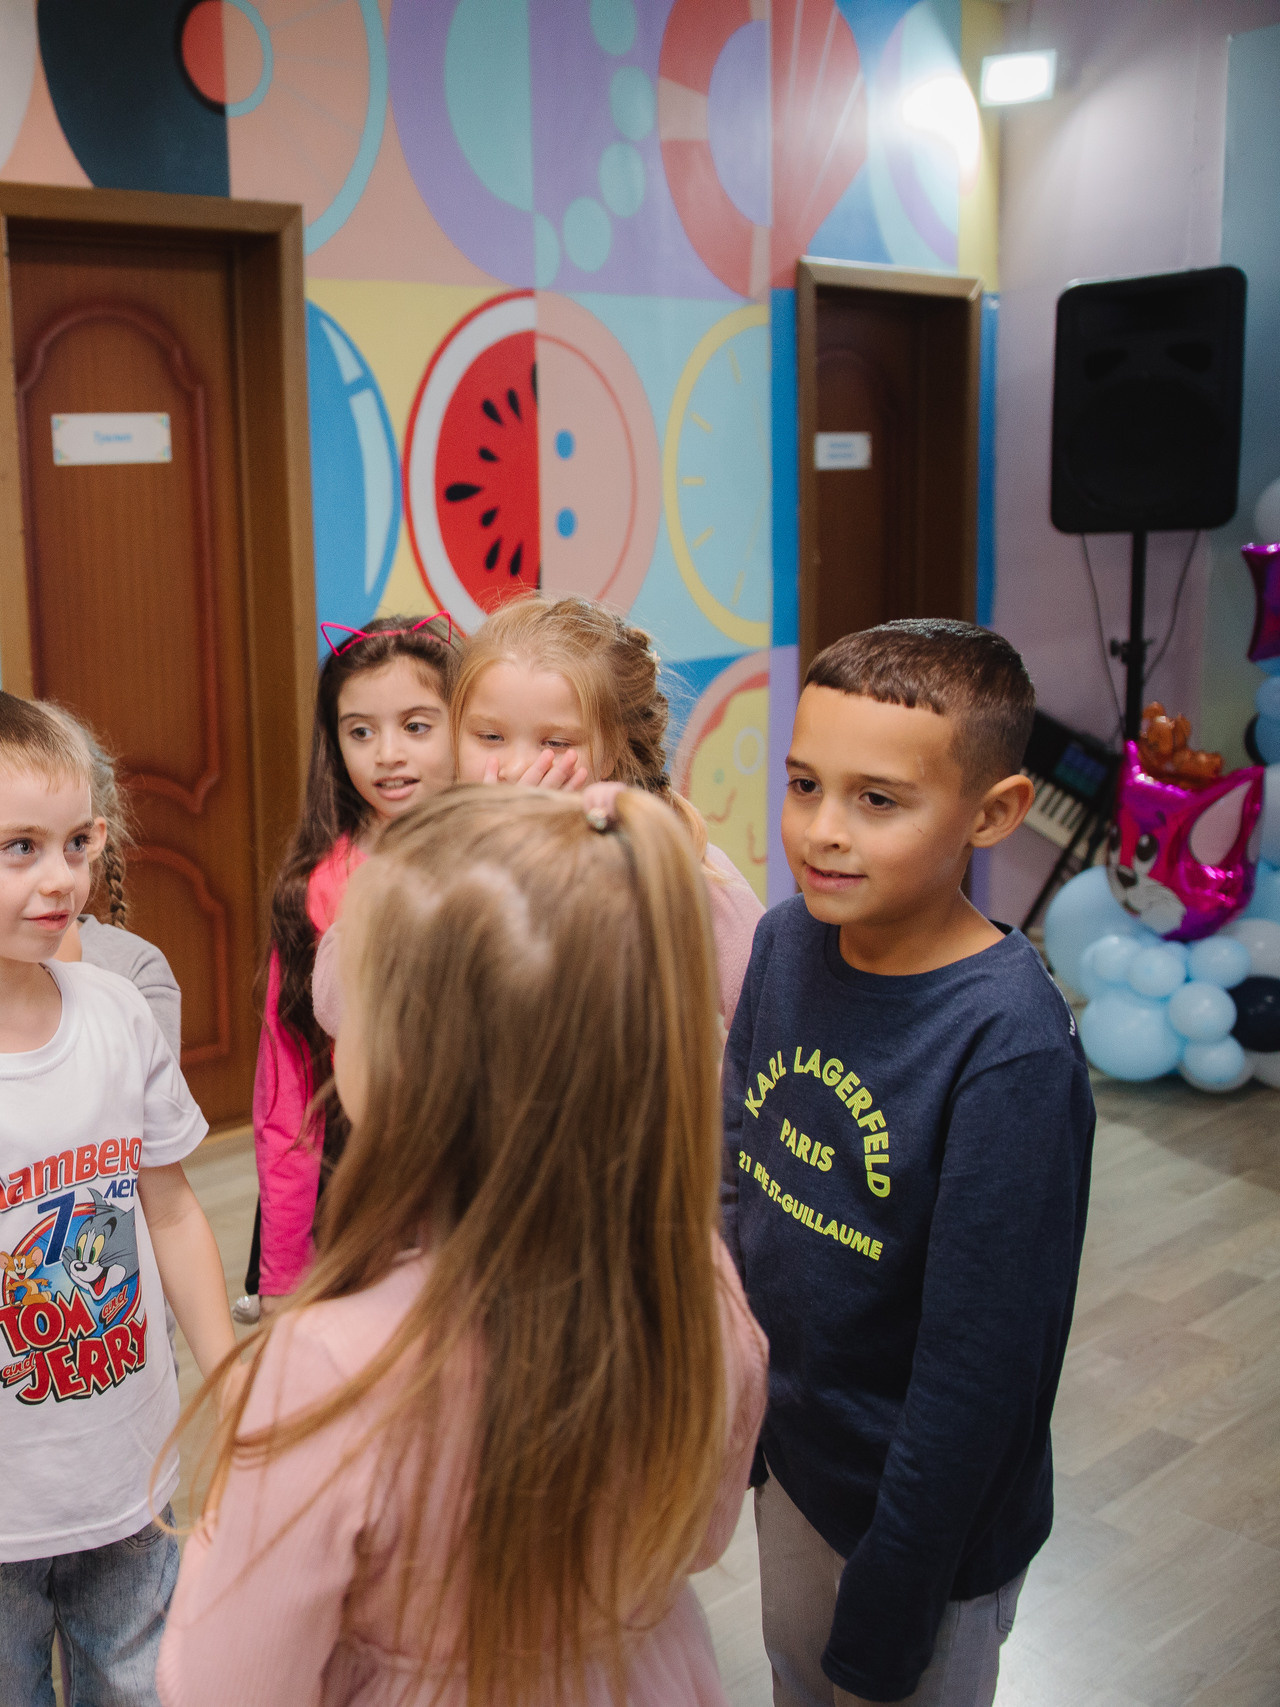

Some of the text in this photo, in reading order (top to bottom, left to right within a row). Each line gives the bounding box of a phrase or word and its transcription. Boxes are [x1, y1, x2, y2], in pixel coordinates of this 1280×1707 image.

[745, 1046, 891, 1198] KARL LAGERFELD
[779, 1118, 836, 1172] PARIS
[37, 1190, 76, 1267] 7
[738, 1150, 752, 1173] 21
[767, 1179, 884, 1261] ST-GUILLAUME
[102, 1284, 128, 1322] and
[16, 1312, 148, 1405] JERRY
